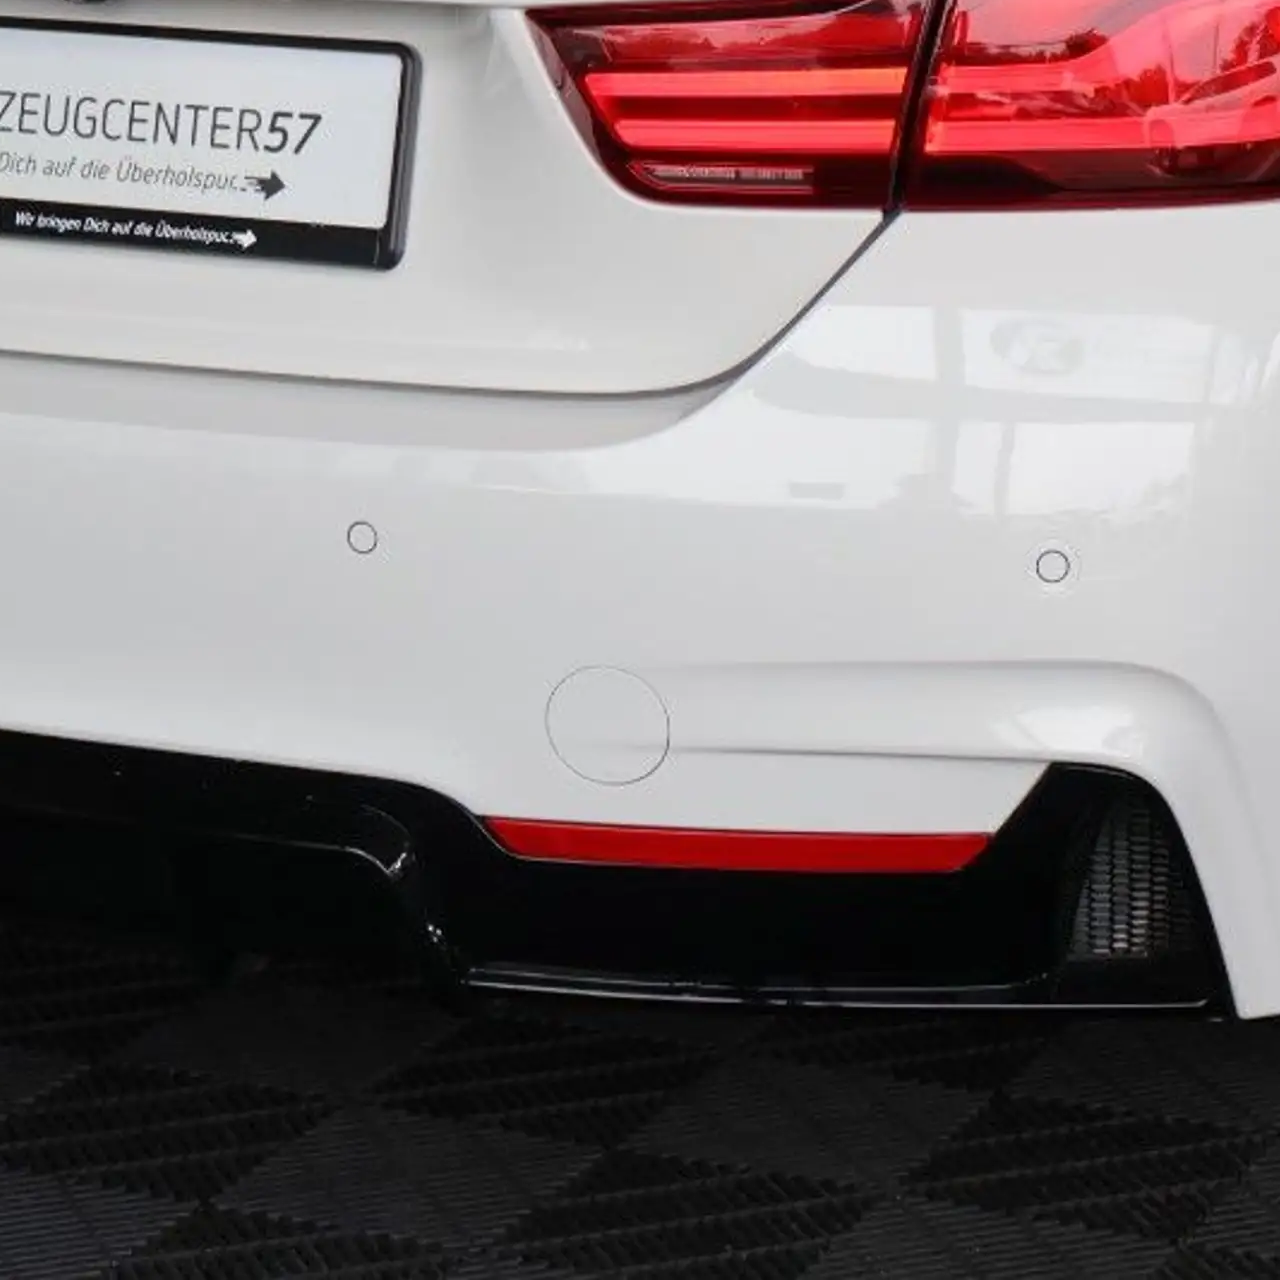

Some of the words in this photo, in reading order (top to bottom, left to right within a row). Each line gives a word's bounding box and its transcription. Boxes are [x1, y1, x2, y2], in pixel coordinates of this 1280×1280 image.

[42, 155, 75, 177] auf
[79, 159, 111, 181] die
[36, 213, 82, 233] bringen
[83, 217, 110, 234] Dich
[111, 220, 134, 236] auf
[134, 222, 155, 238] die
